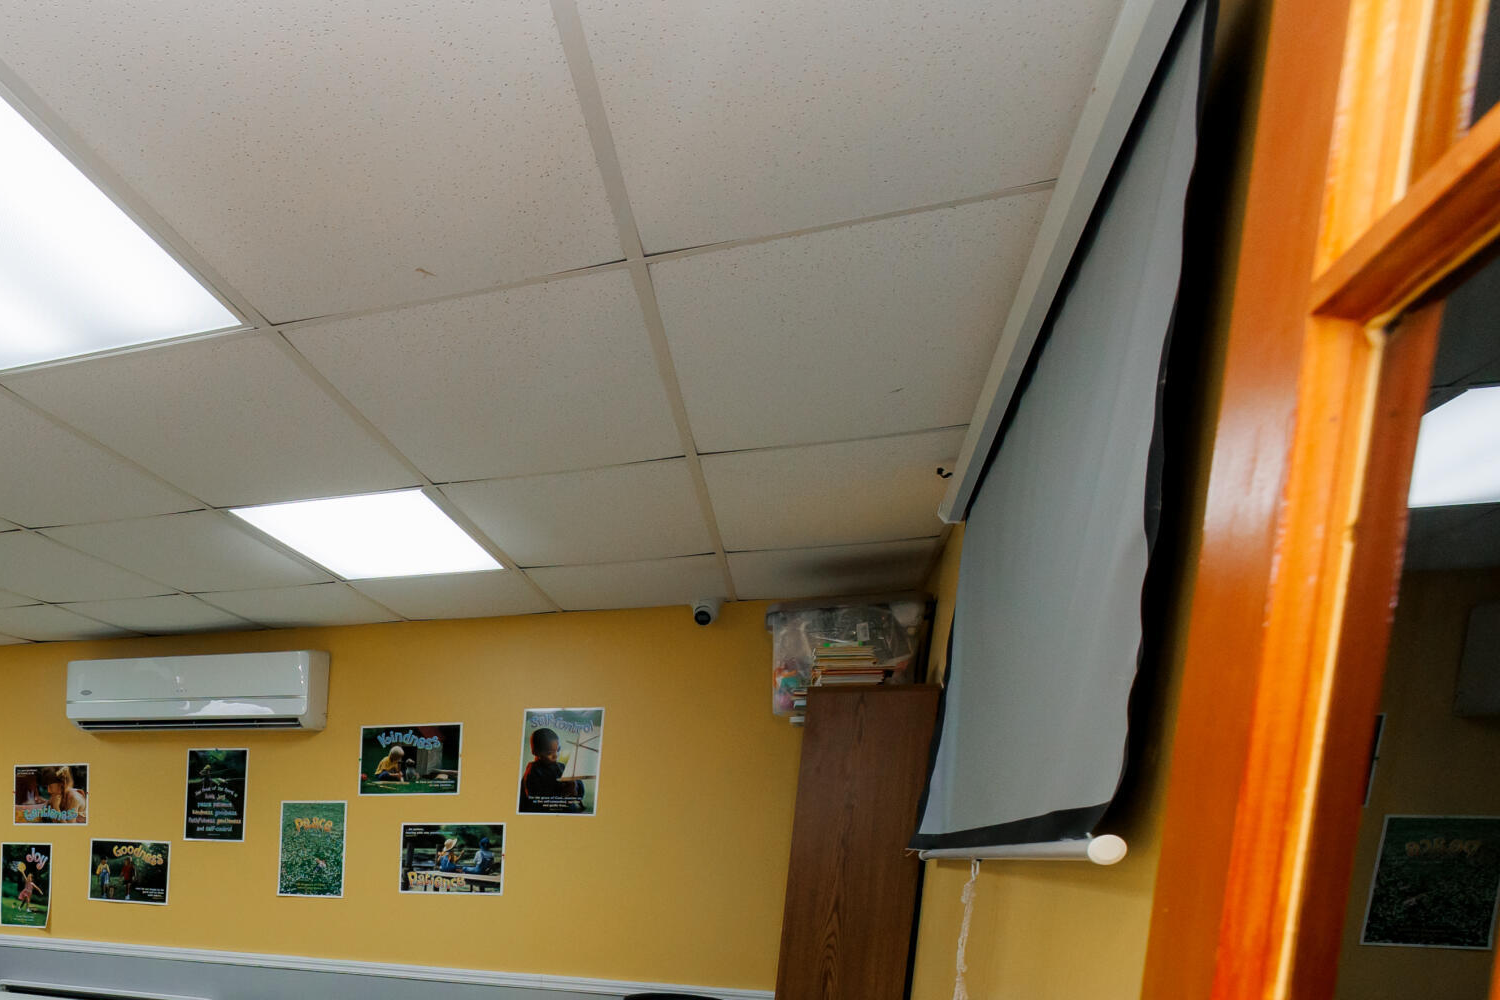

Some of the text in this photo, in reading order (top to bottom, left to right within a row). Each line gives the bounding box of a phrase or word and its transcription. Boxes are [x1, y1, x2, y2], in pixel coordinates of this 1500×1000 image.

[376, 729, 442, 751] Kindness
[25, 847, 50, 871] Joy
[112, 845, 165, 867] Goodness
[407, 871, 467, 889] Patience
